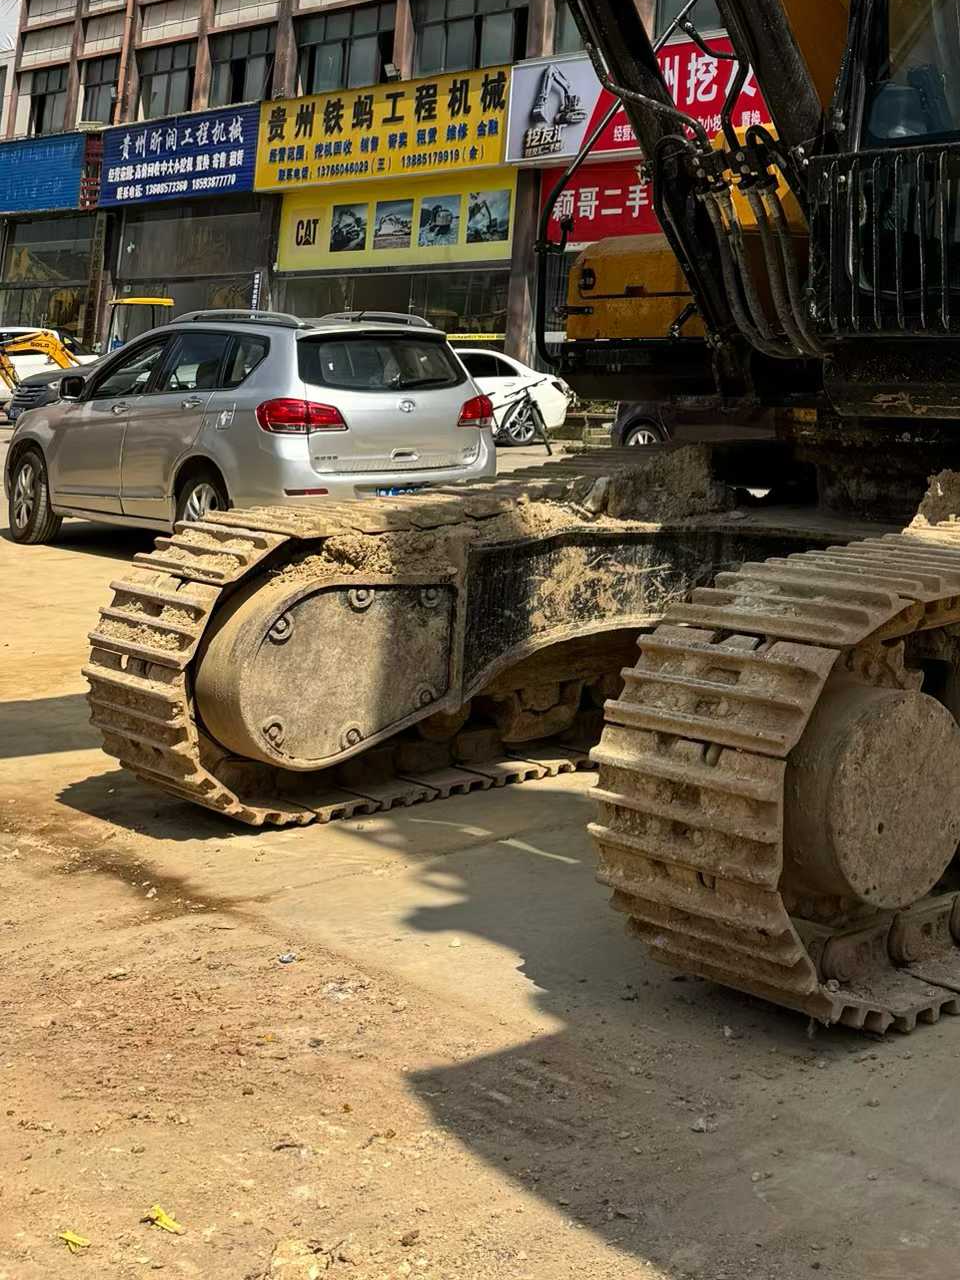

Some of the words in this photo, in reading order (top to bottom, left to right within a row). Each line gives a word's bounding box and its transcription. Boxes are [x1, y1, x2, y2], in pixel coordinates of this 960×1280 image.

[267, 71, 508, 142] 贵州铁蚂工程机械
[552, 184, 654, 221] 颖哥二手
[296, 219, 319, 246] CAT
